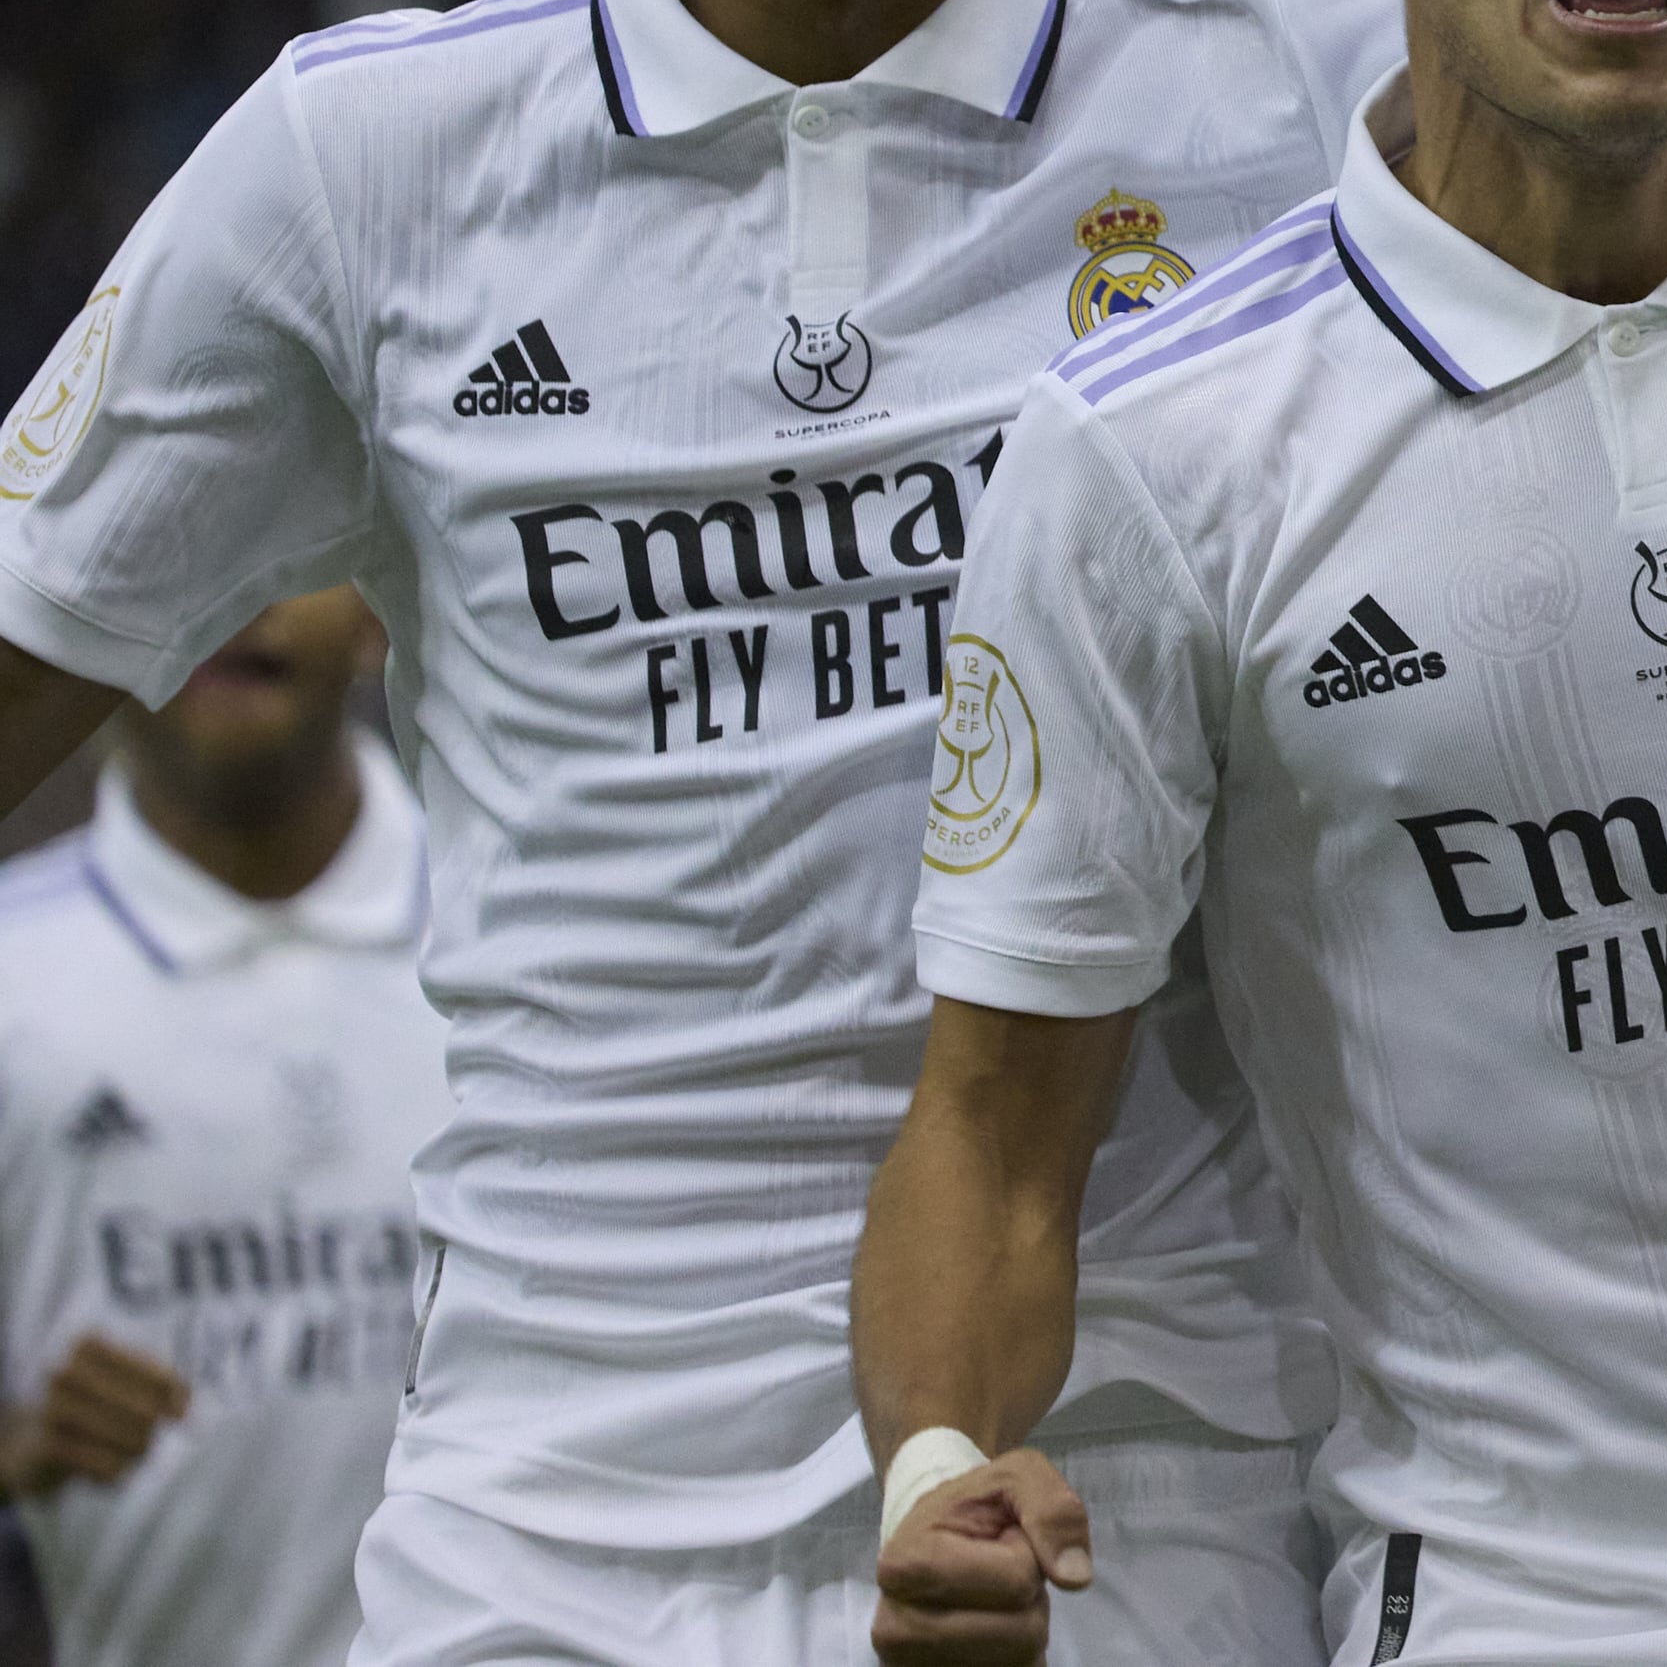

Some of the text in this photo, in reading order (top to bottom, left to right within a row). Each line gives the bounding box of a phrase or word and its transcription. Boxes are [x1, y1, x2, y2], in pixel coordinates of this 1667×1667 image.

[452, 379, 590, 416] adidas
[774, 410, 891, 439] SUPERCOPA
[647, 586, 951, 754] FLY BET
[1303, 645, 1447, 709] adidas
